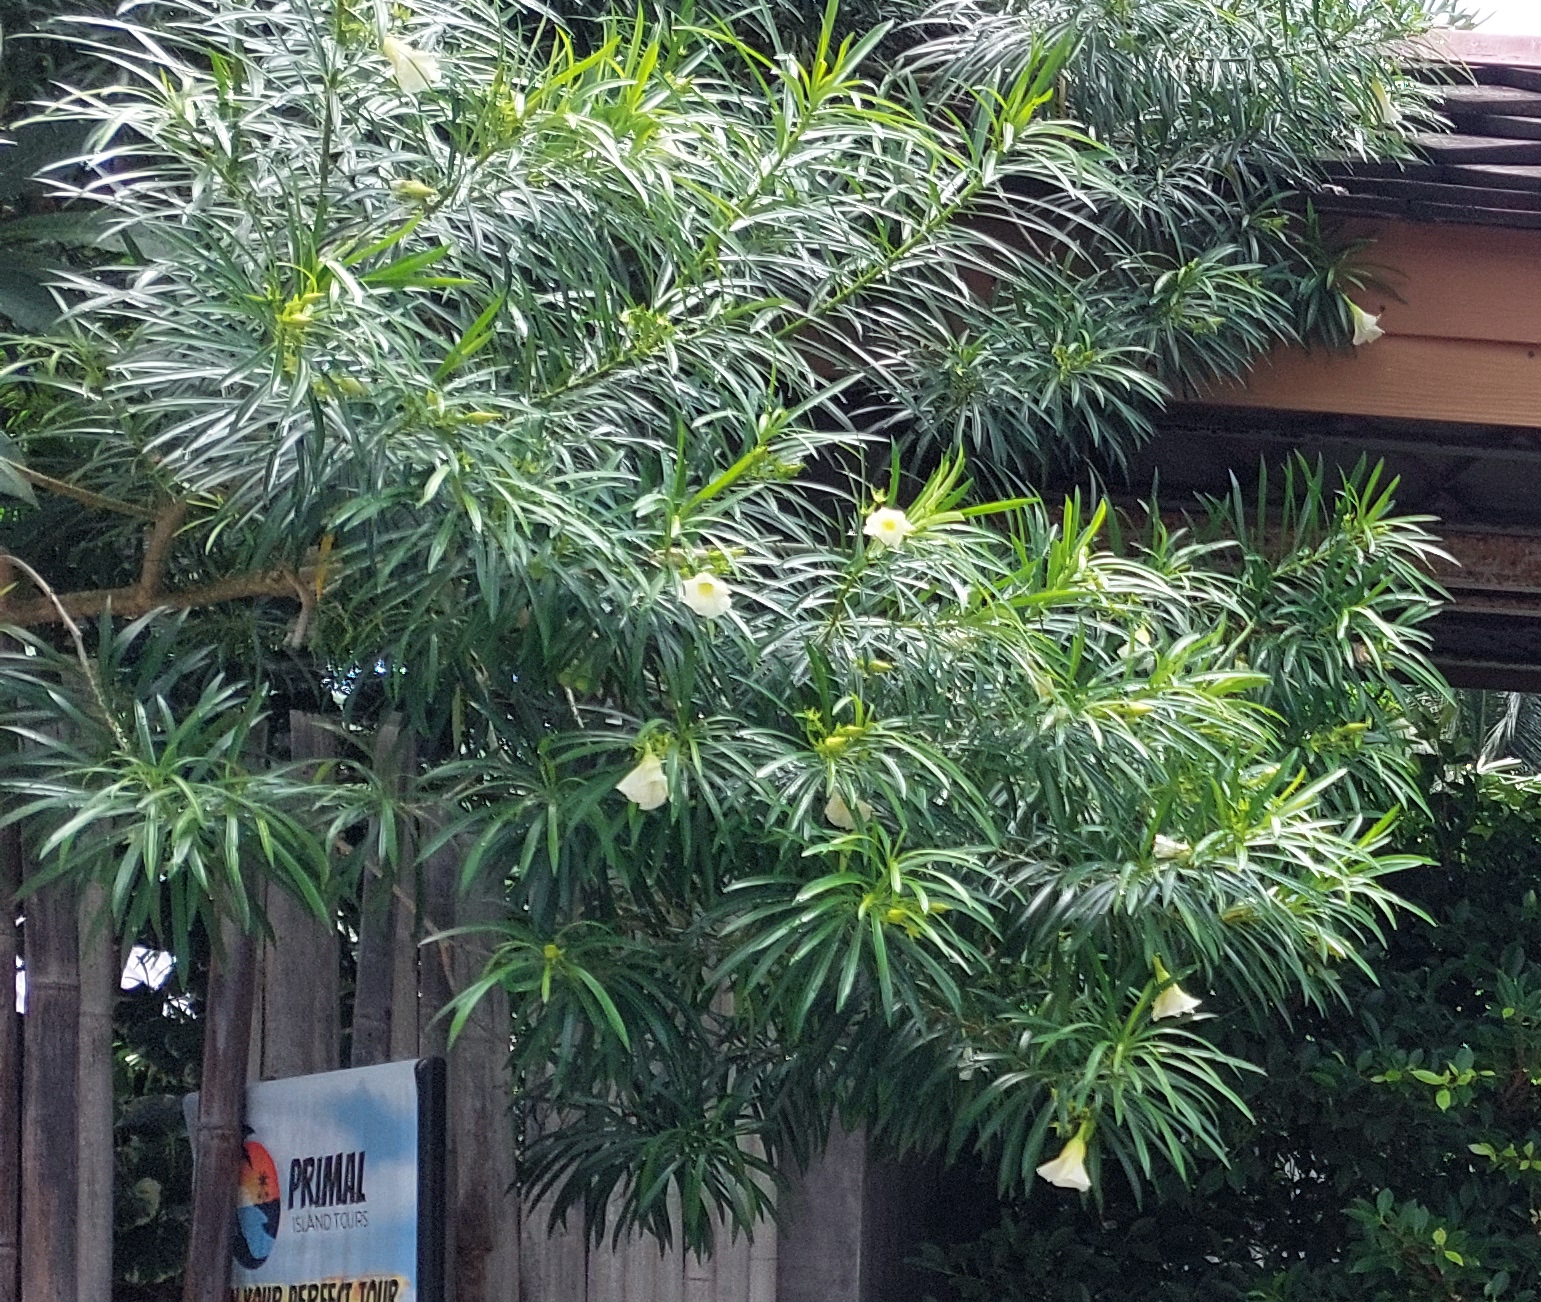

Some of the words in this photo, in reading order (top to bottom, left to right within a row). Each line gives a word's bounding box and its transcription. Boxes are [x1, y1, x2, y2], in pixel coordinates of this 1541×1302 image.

[287, 1151, 366, 1210] PRIMAL
[292, 1216, 331, 1233] ISLAND
[334, 1210, 369, 1230] TOURS
